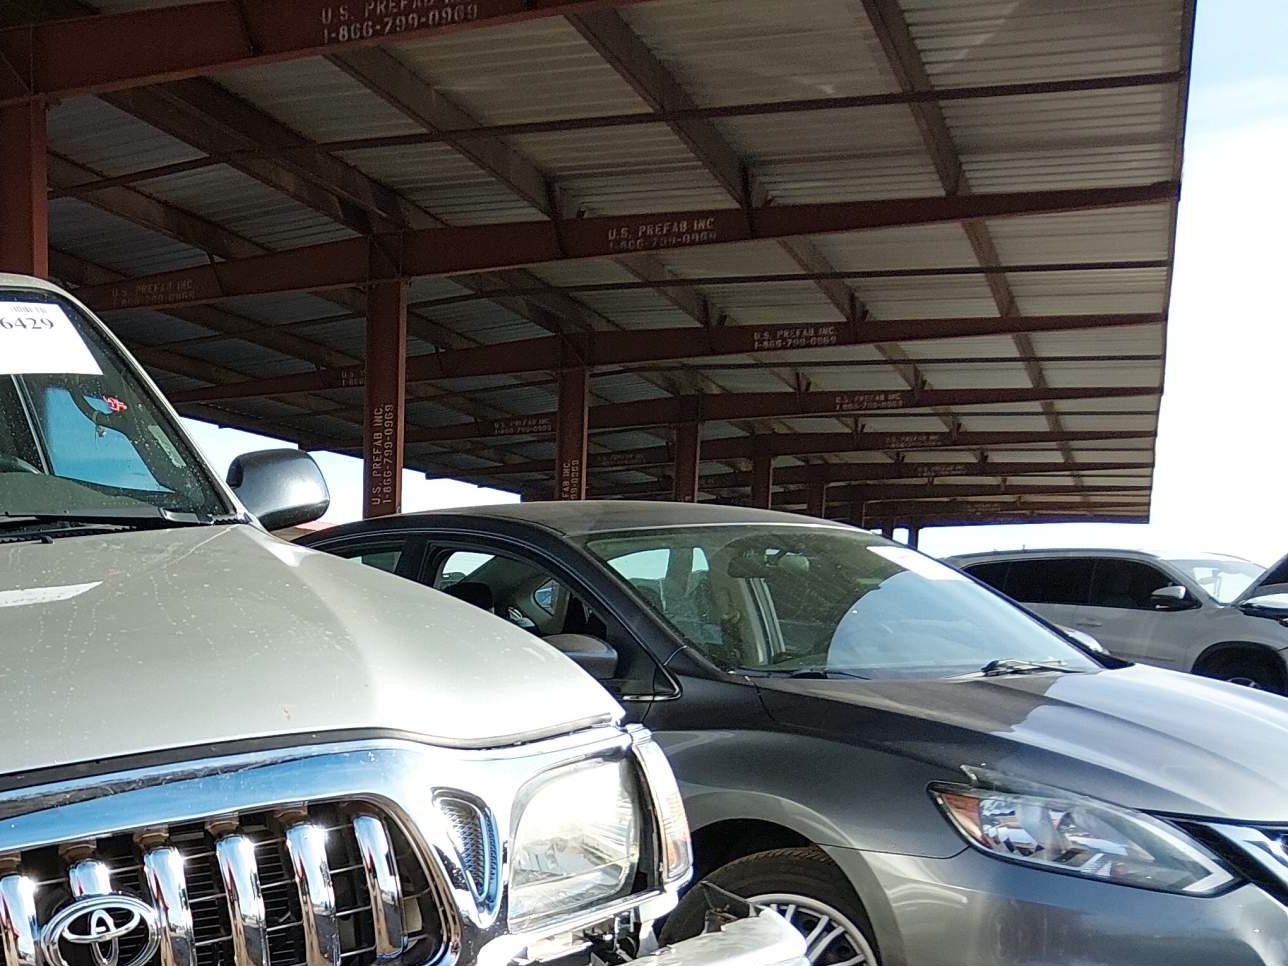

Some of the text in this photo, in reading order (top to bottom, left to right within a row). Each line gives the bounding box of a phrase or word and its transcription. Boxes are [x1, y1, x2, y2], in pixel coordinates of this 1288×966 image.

[608, 227, 632, 240] U.S.
[639, 221, 688, 236] PREFAB
[372, 432, 383, 477] PREFAB
[383, 404, 394, 503] 1-866-799-0969
[372, 482, 383, 505] U.S.
